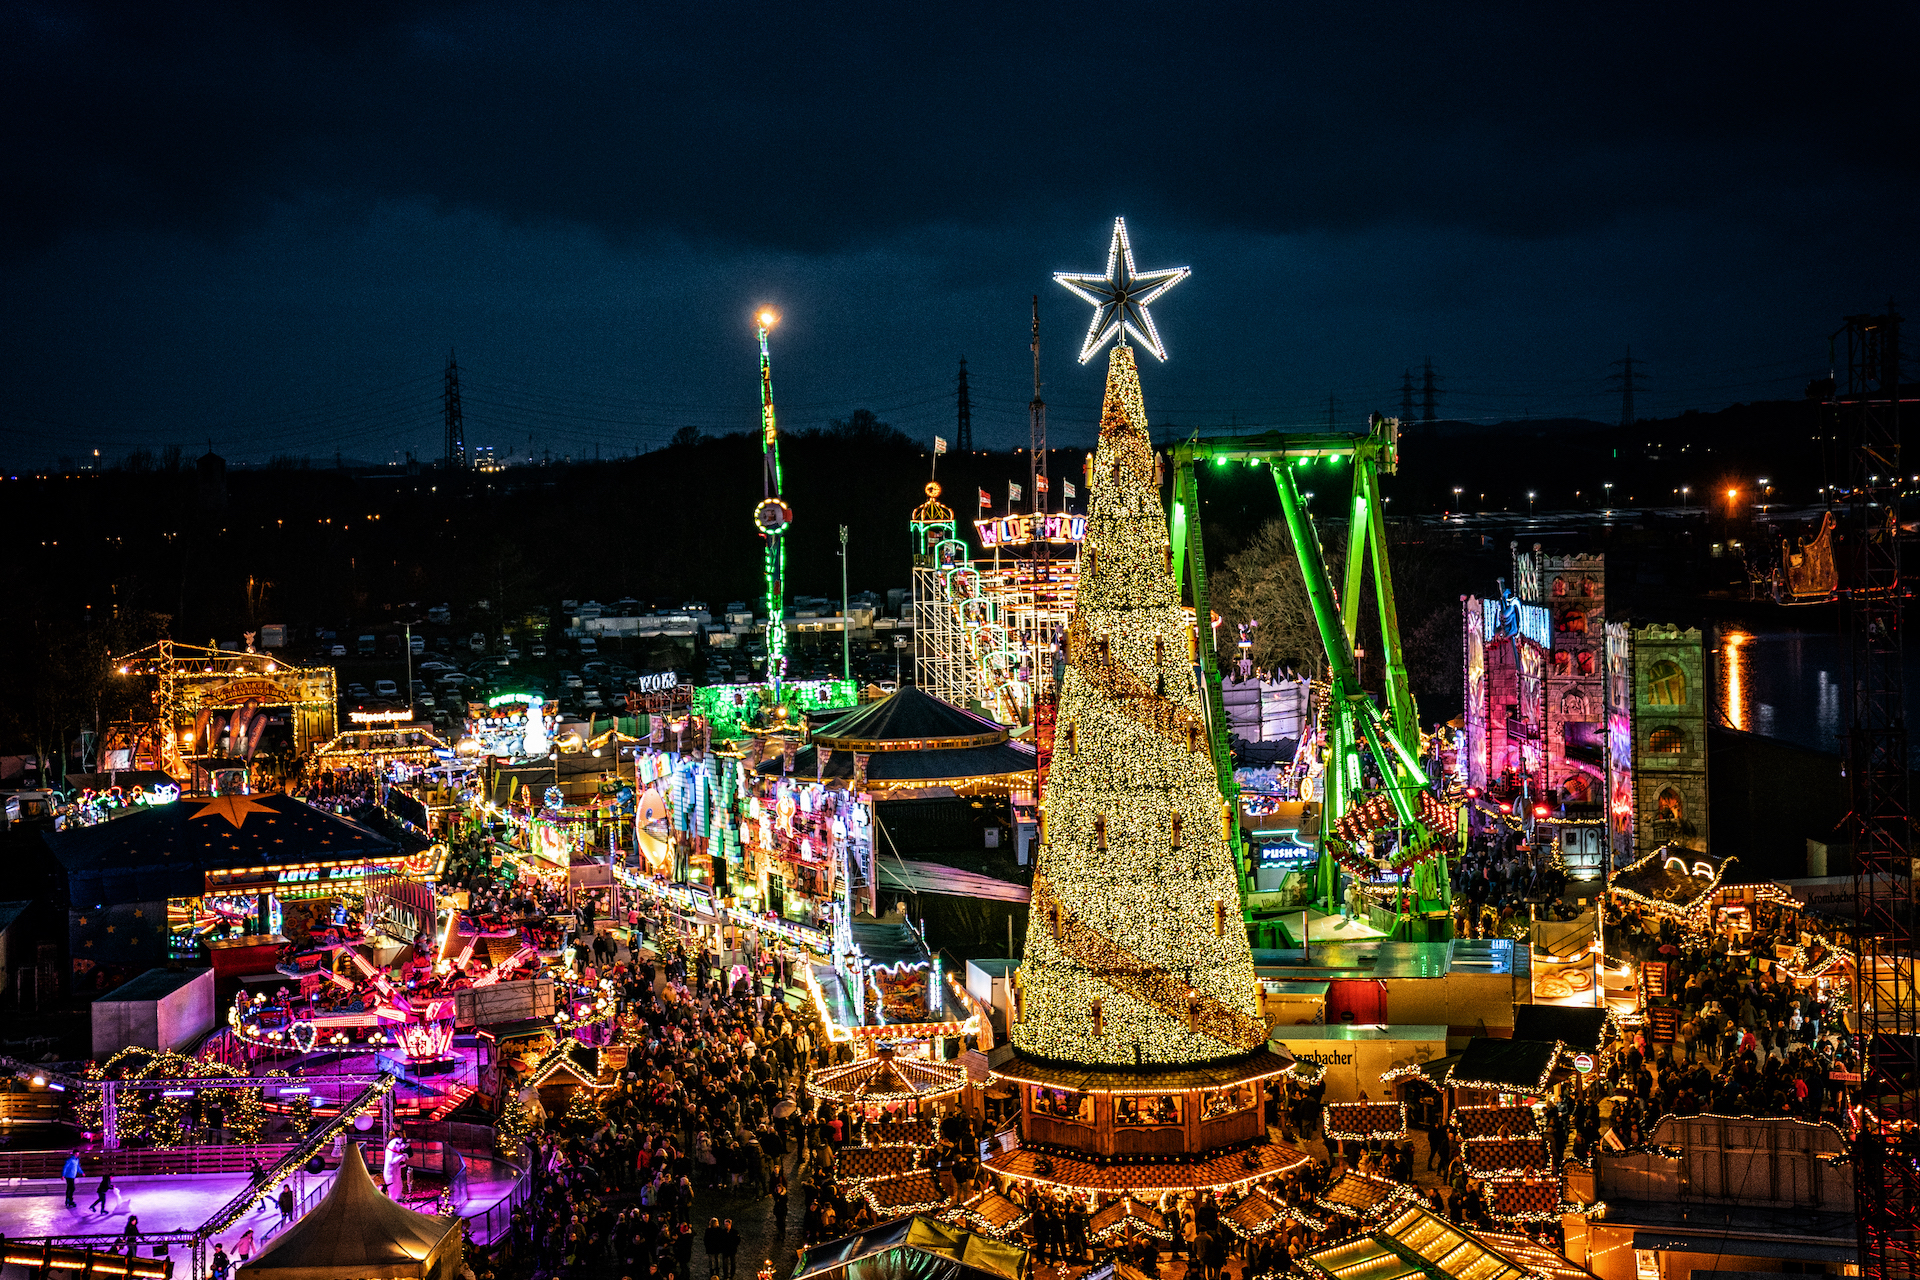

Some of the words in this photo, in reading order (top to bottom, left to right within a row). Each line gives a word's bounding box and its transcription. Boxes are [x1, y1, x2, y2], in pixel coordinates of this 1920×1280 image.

[980, 518, 1030, 544] WILDE
[1263, 847, 1308, 859] PUSHER
[278, 867, 320, 884] LOVE
[1807, 890, 1854, 905] Krombache
[1831, 1072, 1860, 1080] Toiletten
